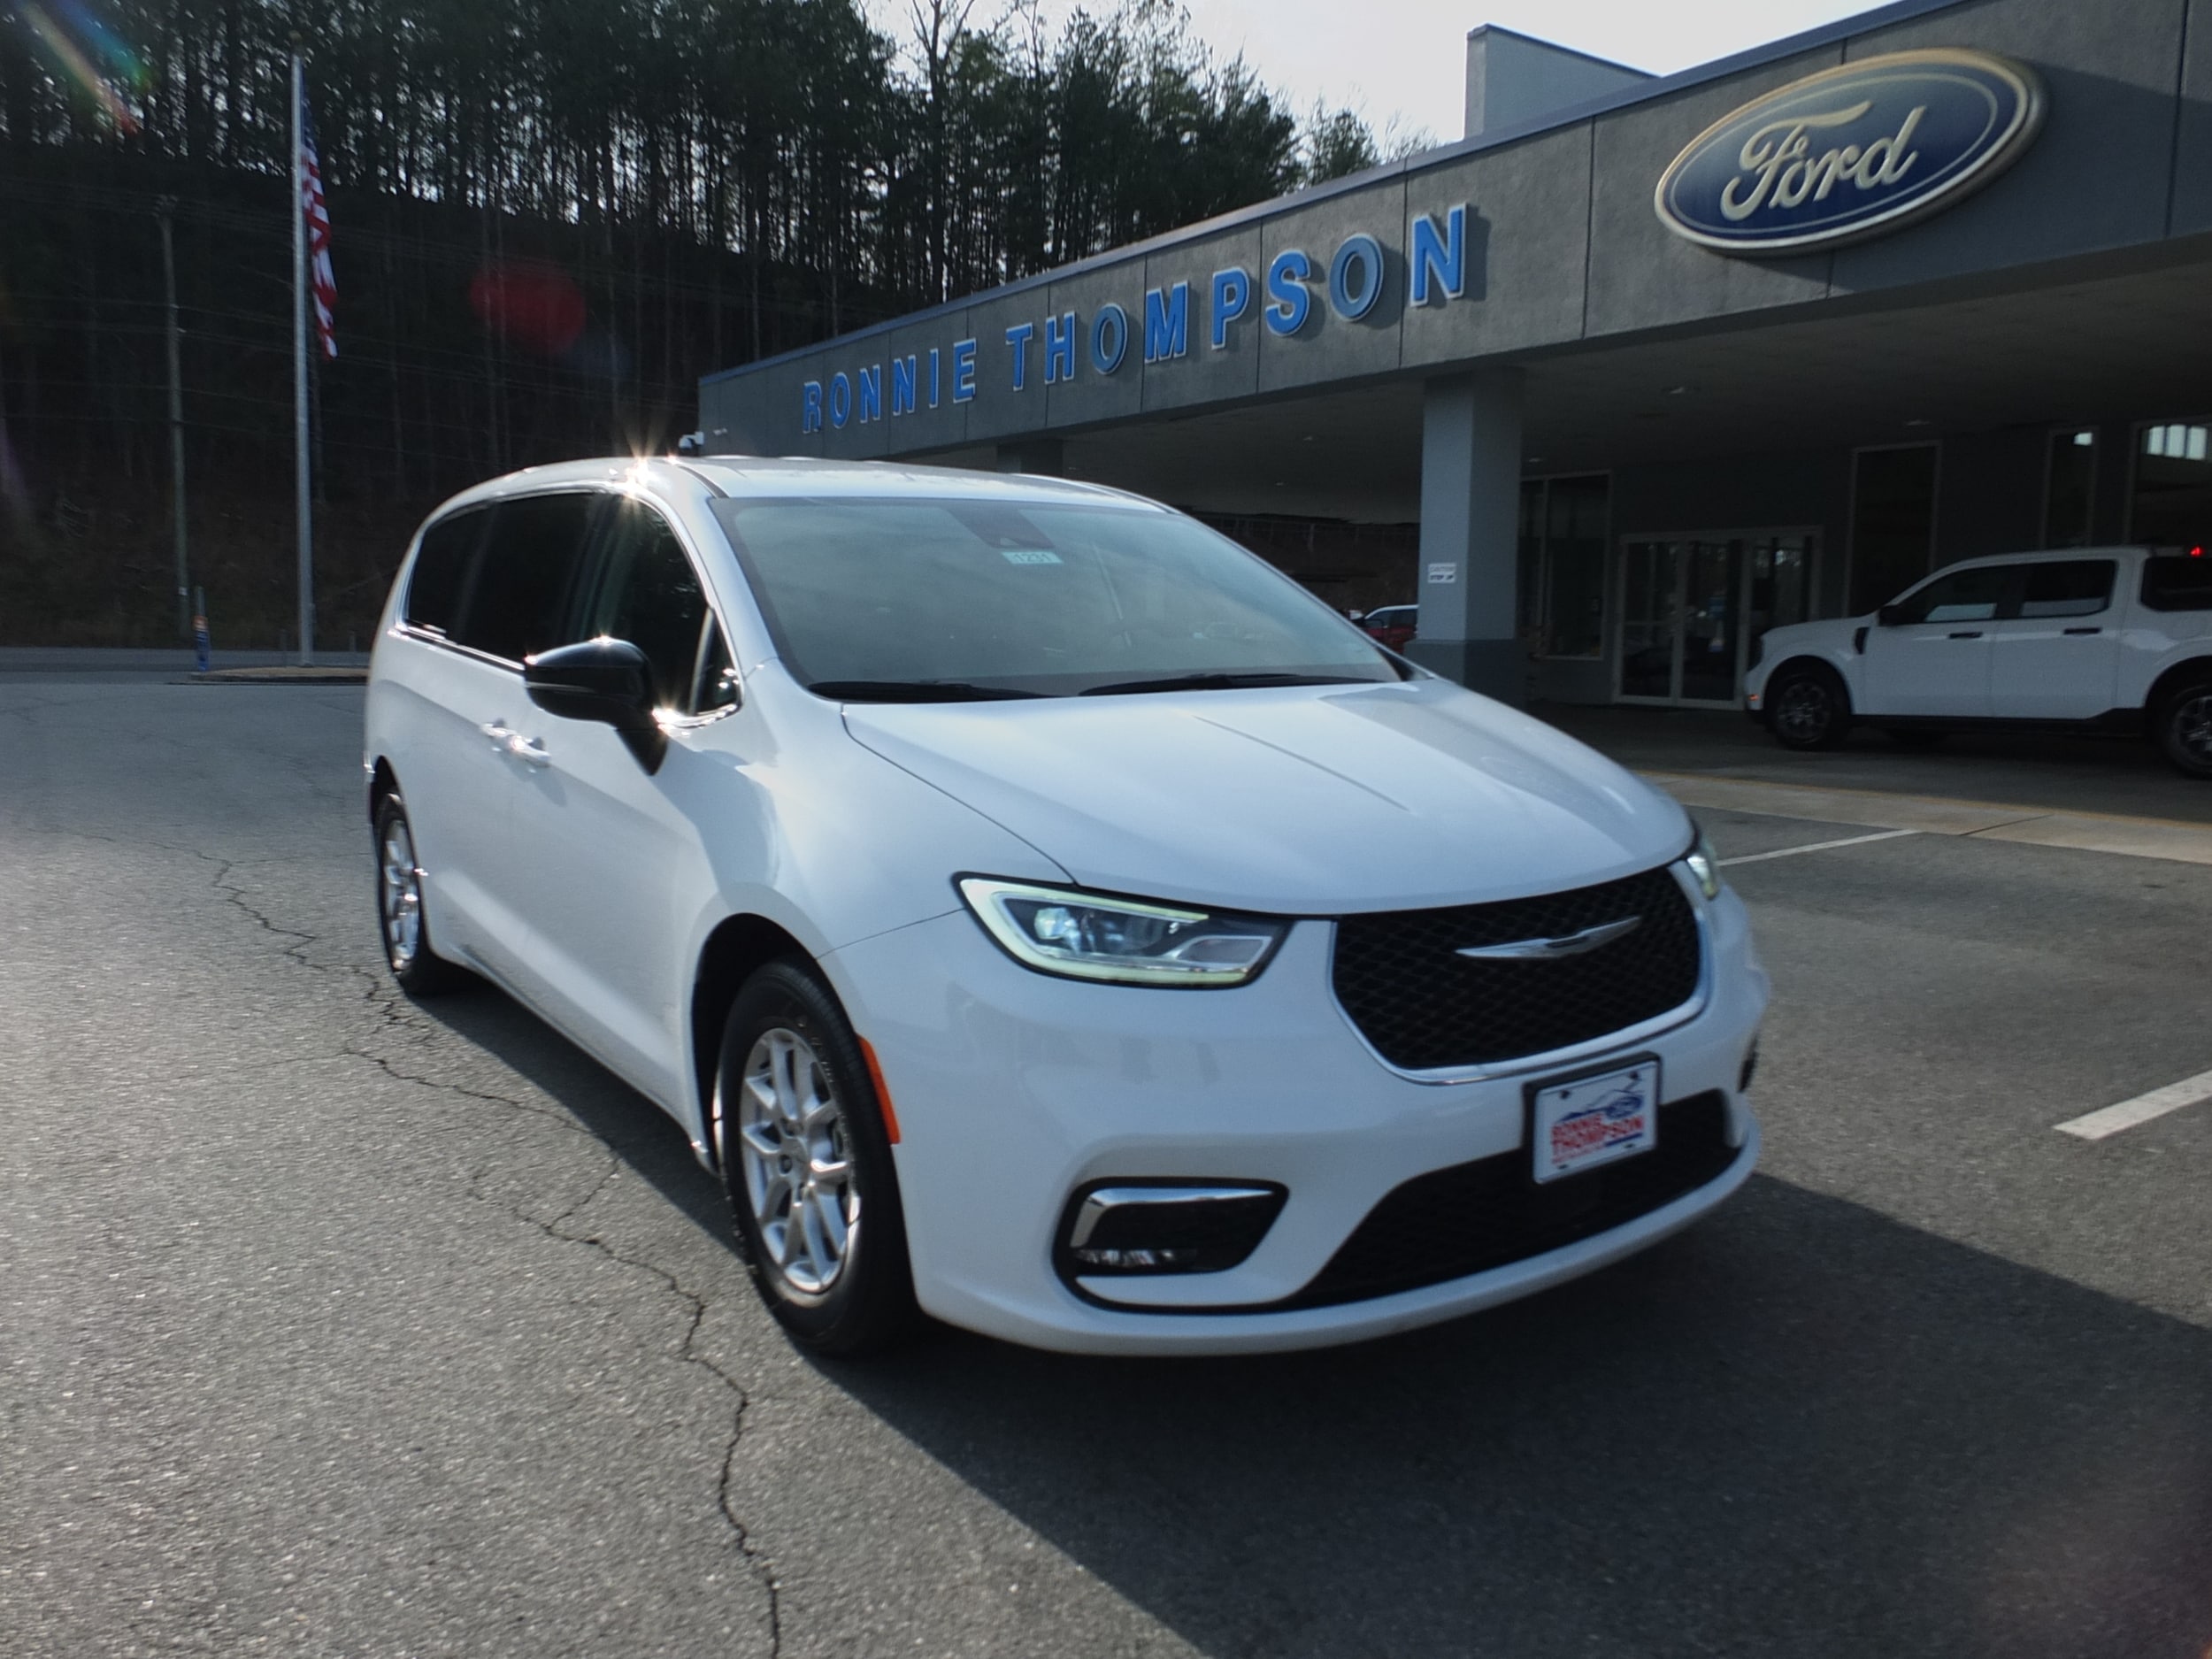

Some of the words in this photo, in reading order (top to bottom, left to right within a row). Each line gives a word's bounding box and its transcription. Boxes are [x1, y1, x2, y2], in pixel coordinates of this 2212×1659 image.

[1720, 100, 1926, 221] Ford
[803, 337, 977, 434] RONNIE
[1005, 203, 1469, 393] THOMPSON
